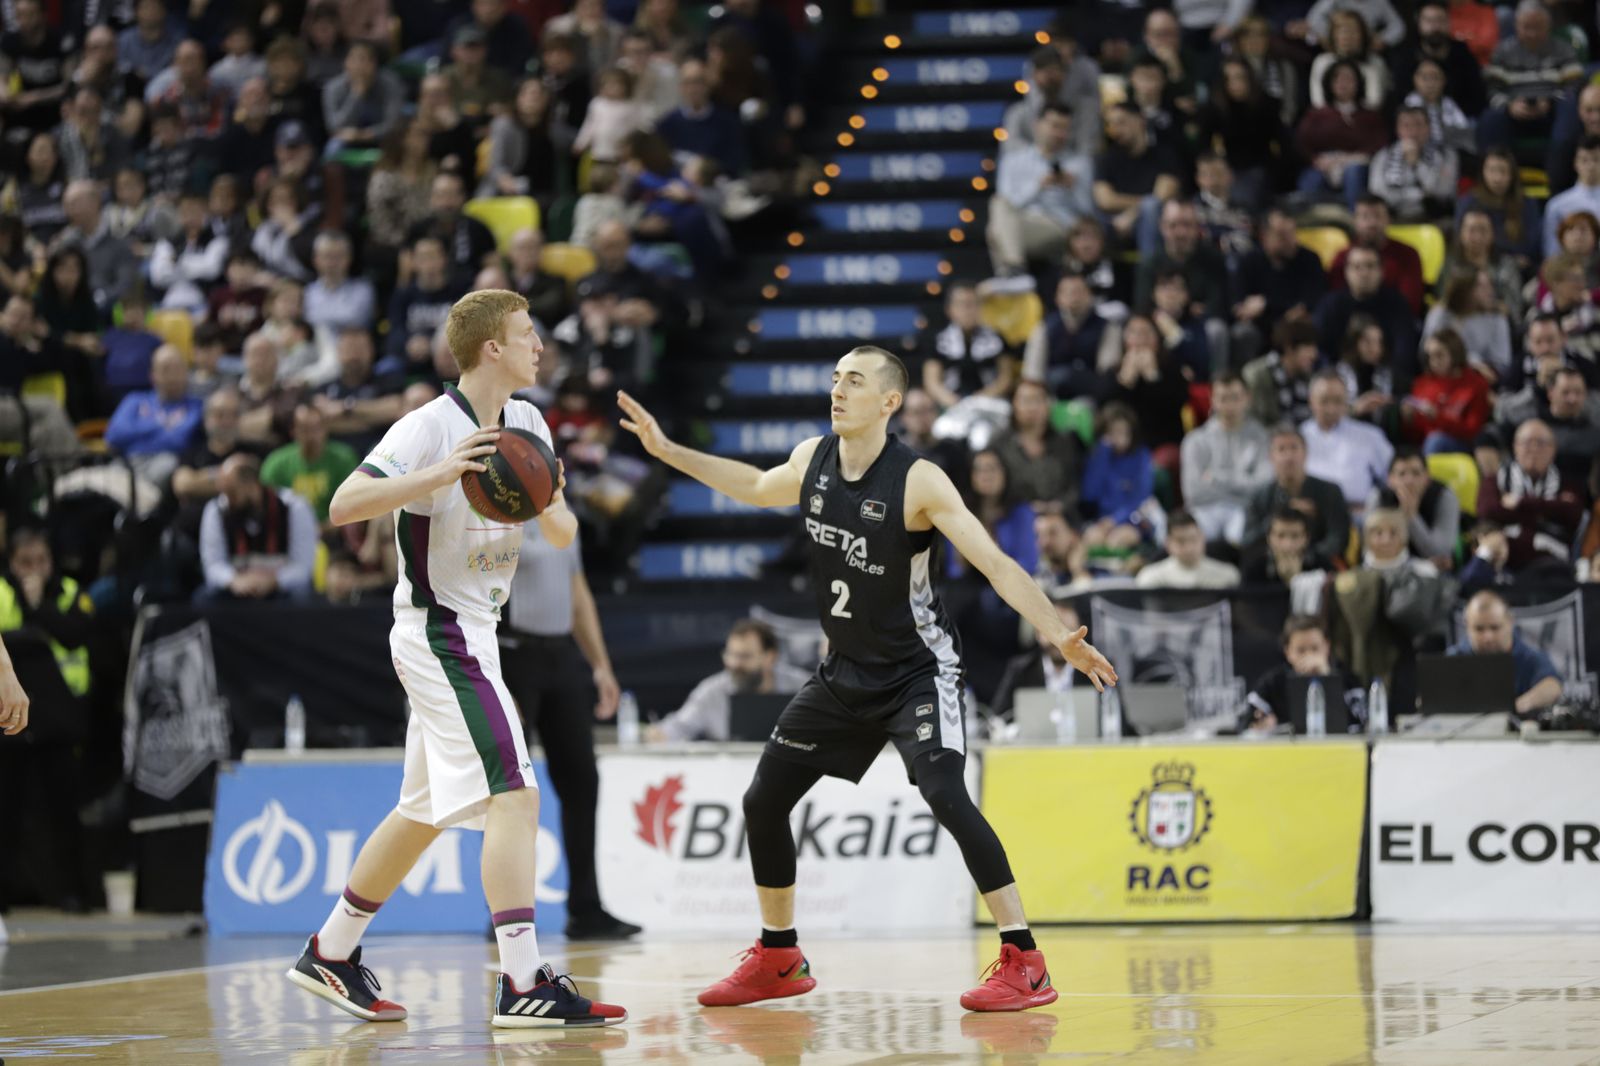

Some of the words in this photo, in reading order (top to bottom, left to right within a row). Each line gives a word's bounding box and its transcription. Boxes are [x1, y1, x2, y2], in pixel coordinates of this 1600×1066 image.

[805, 517, 867, 563] RETA
[848, 556, 885, 576] bet.es
[830, 579, 852, 618] 2
[682, 800, 939, 860] Bikaia
[1380, 824, 1453, 863] EL
[1127, 865, 1211, 891] RAC
